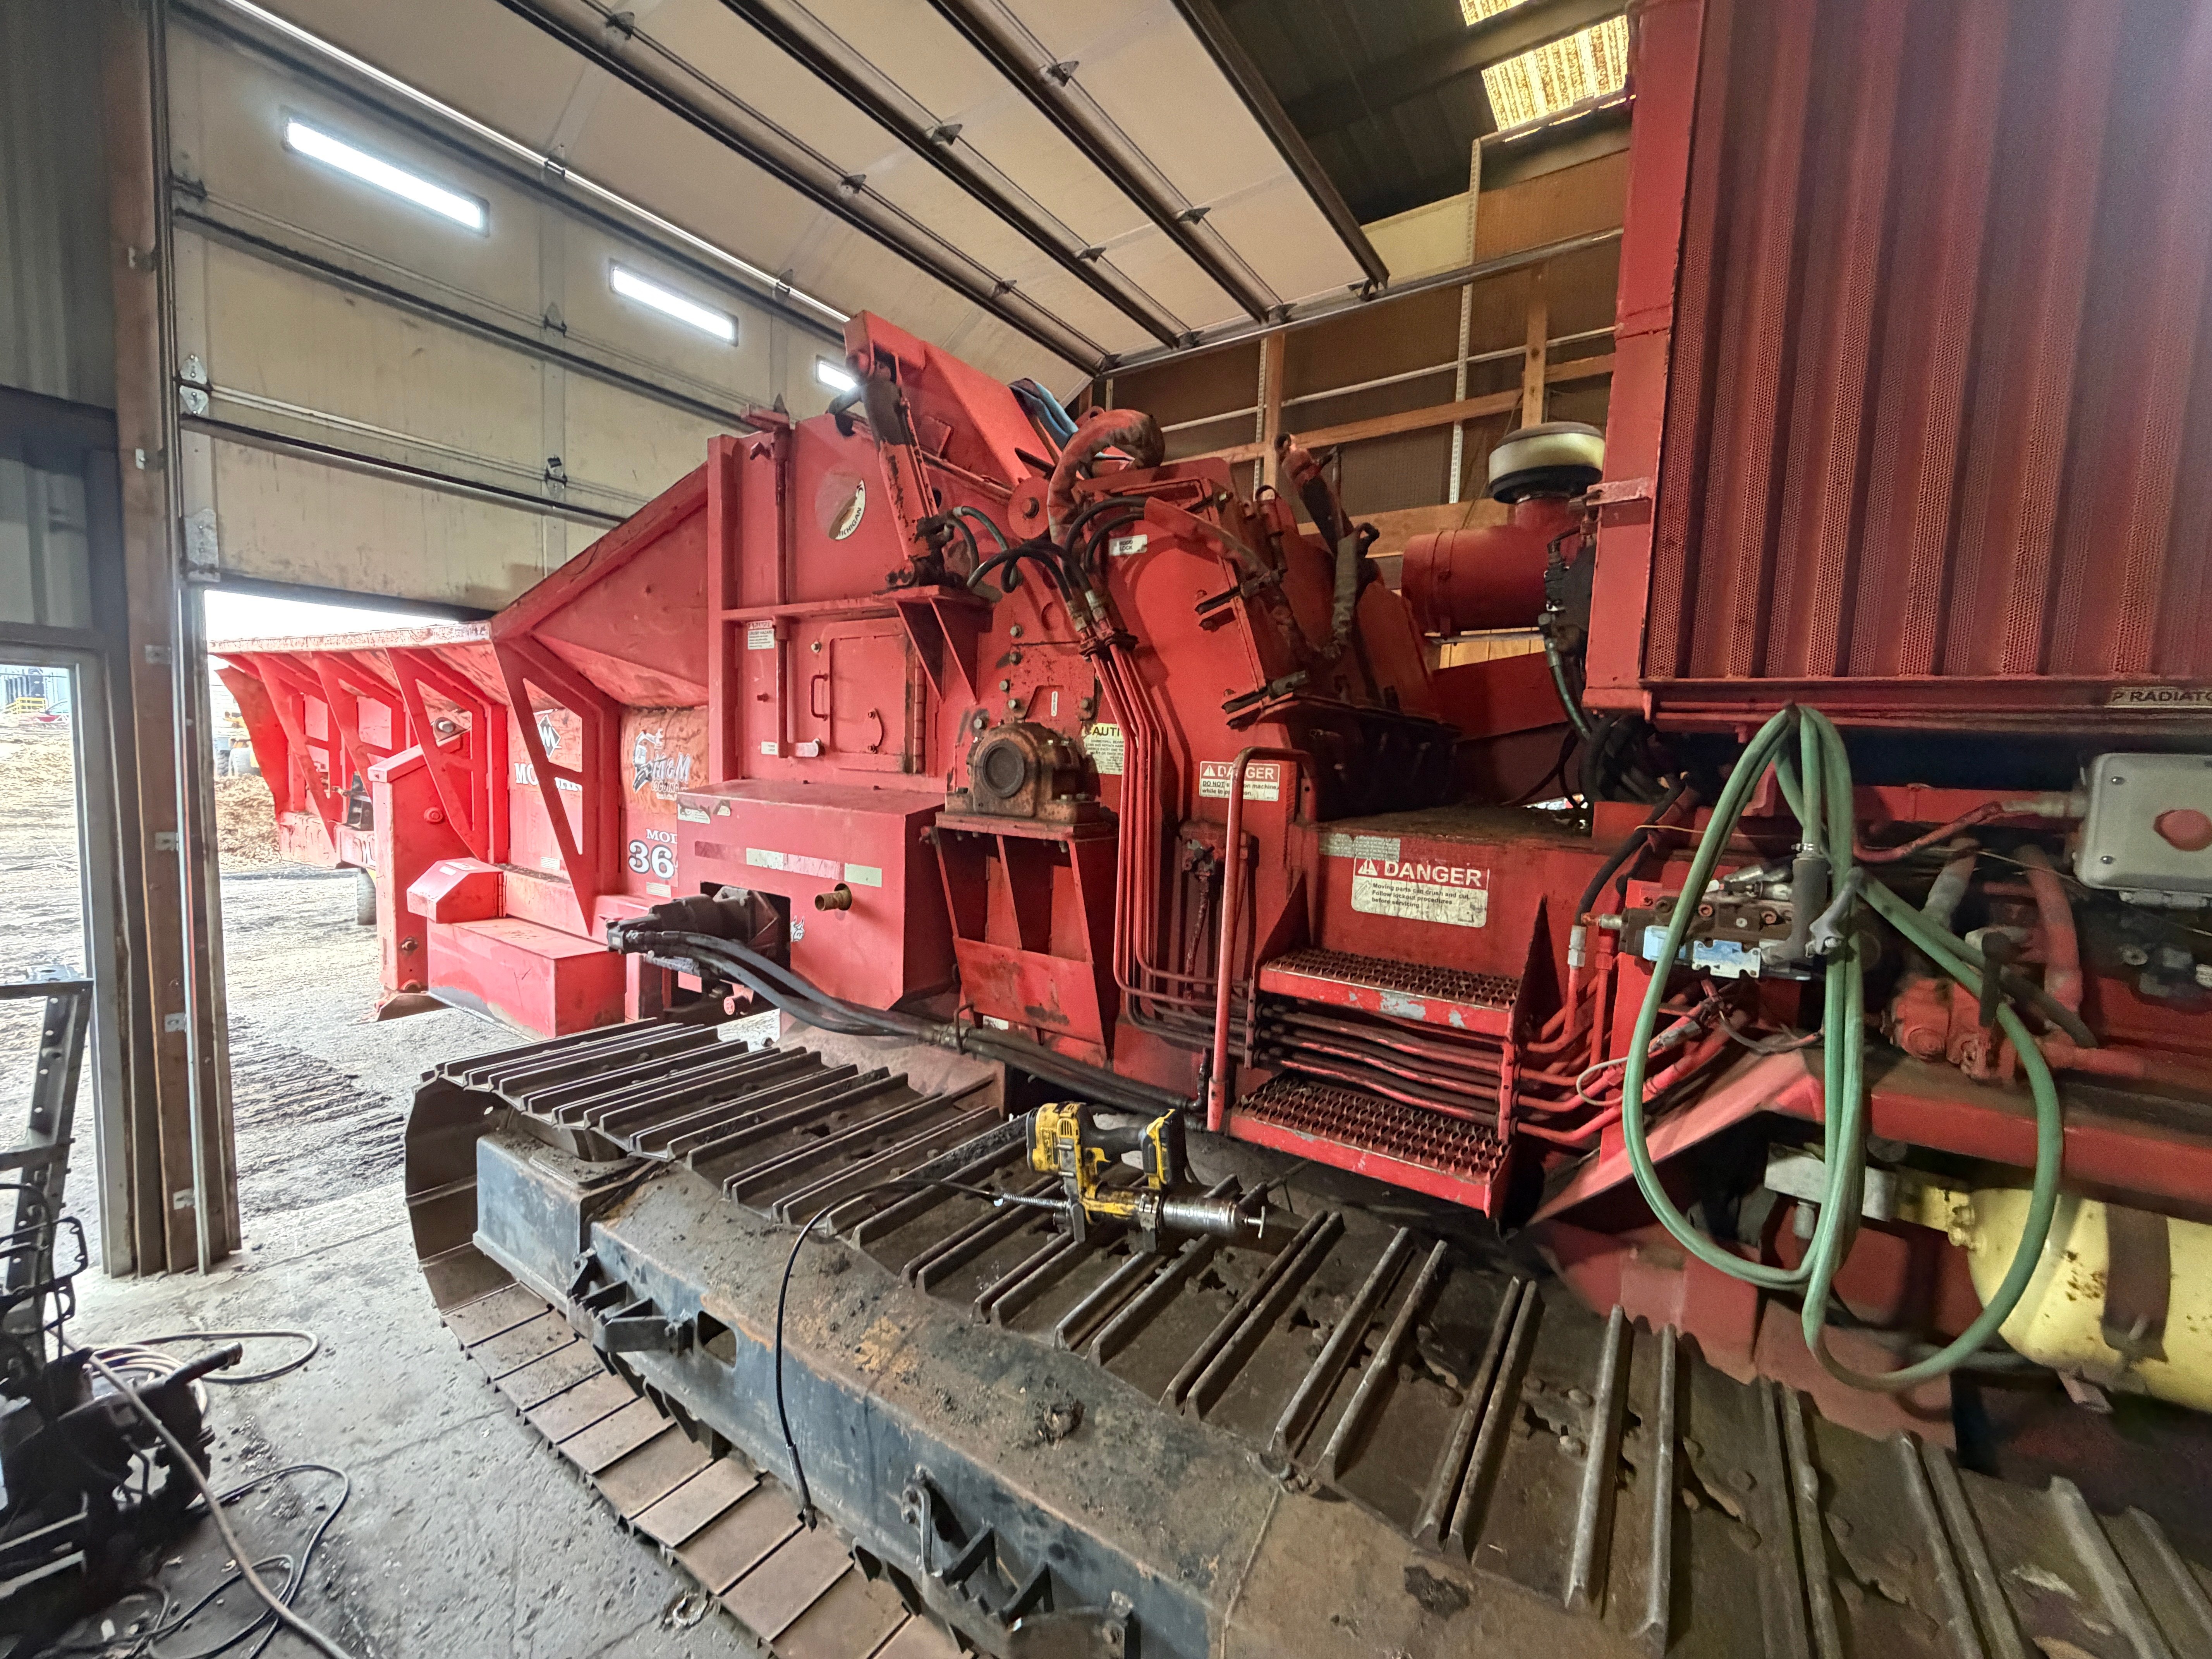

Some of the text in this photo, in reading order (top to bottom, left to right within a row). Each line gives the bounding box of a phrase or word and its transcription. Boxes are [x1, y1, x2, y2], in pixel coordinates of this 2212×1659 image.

[1092, 726, 1120, 737] AUTI
[1218, 765, 1274, 780] DAGER
[646, 828, 678, 844] MOD
[629, 840, 675, 879] 36
[1384, 860, 1482, 887] DANGER
[1373, 883, 1394, 891] Moving
[1417, 896, 1452, 905] procedures
